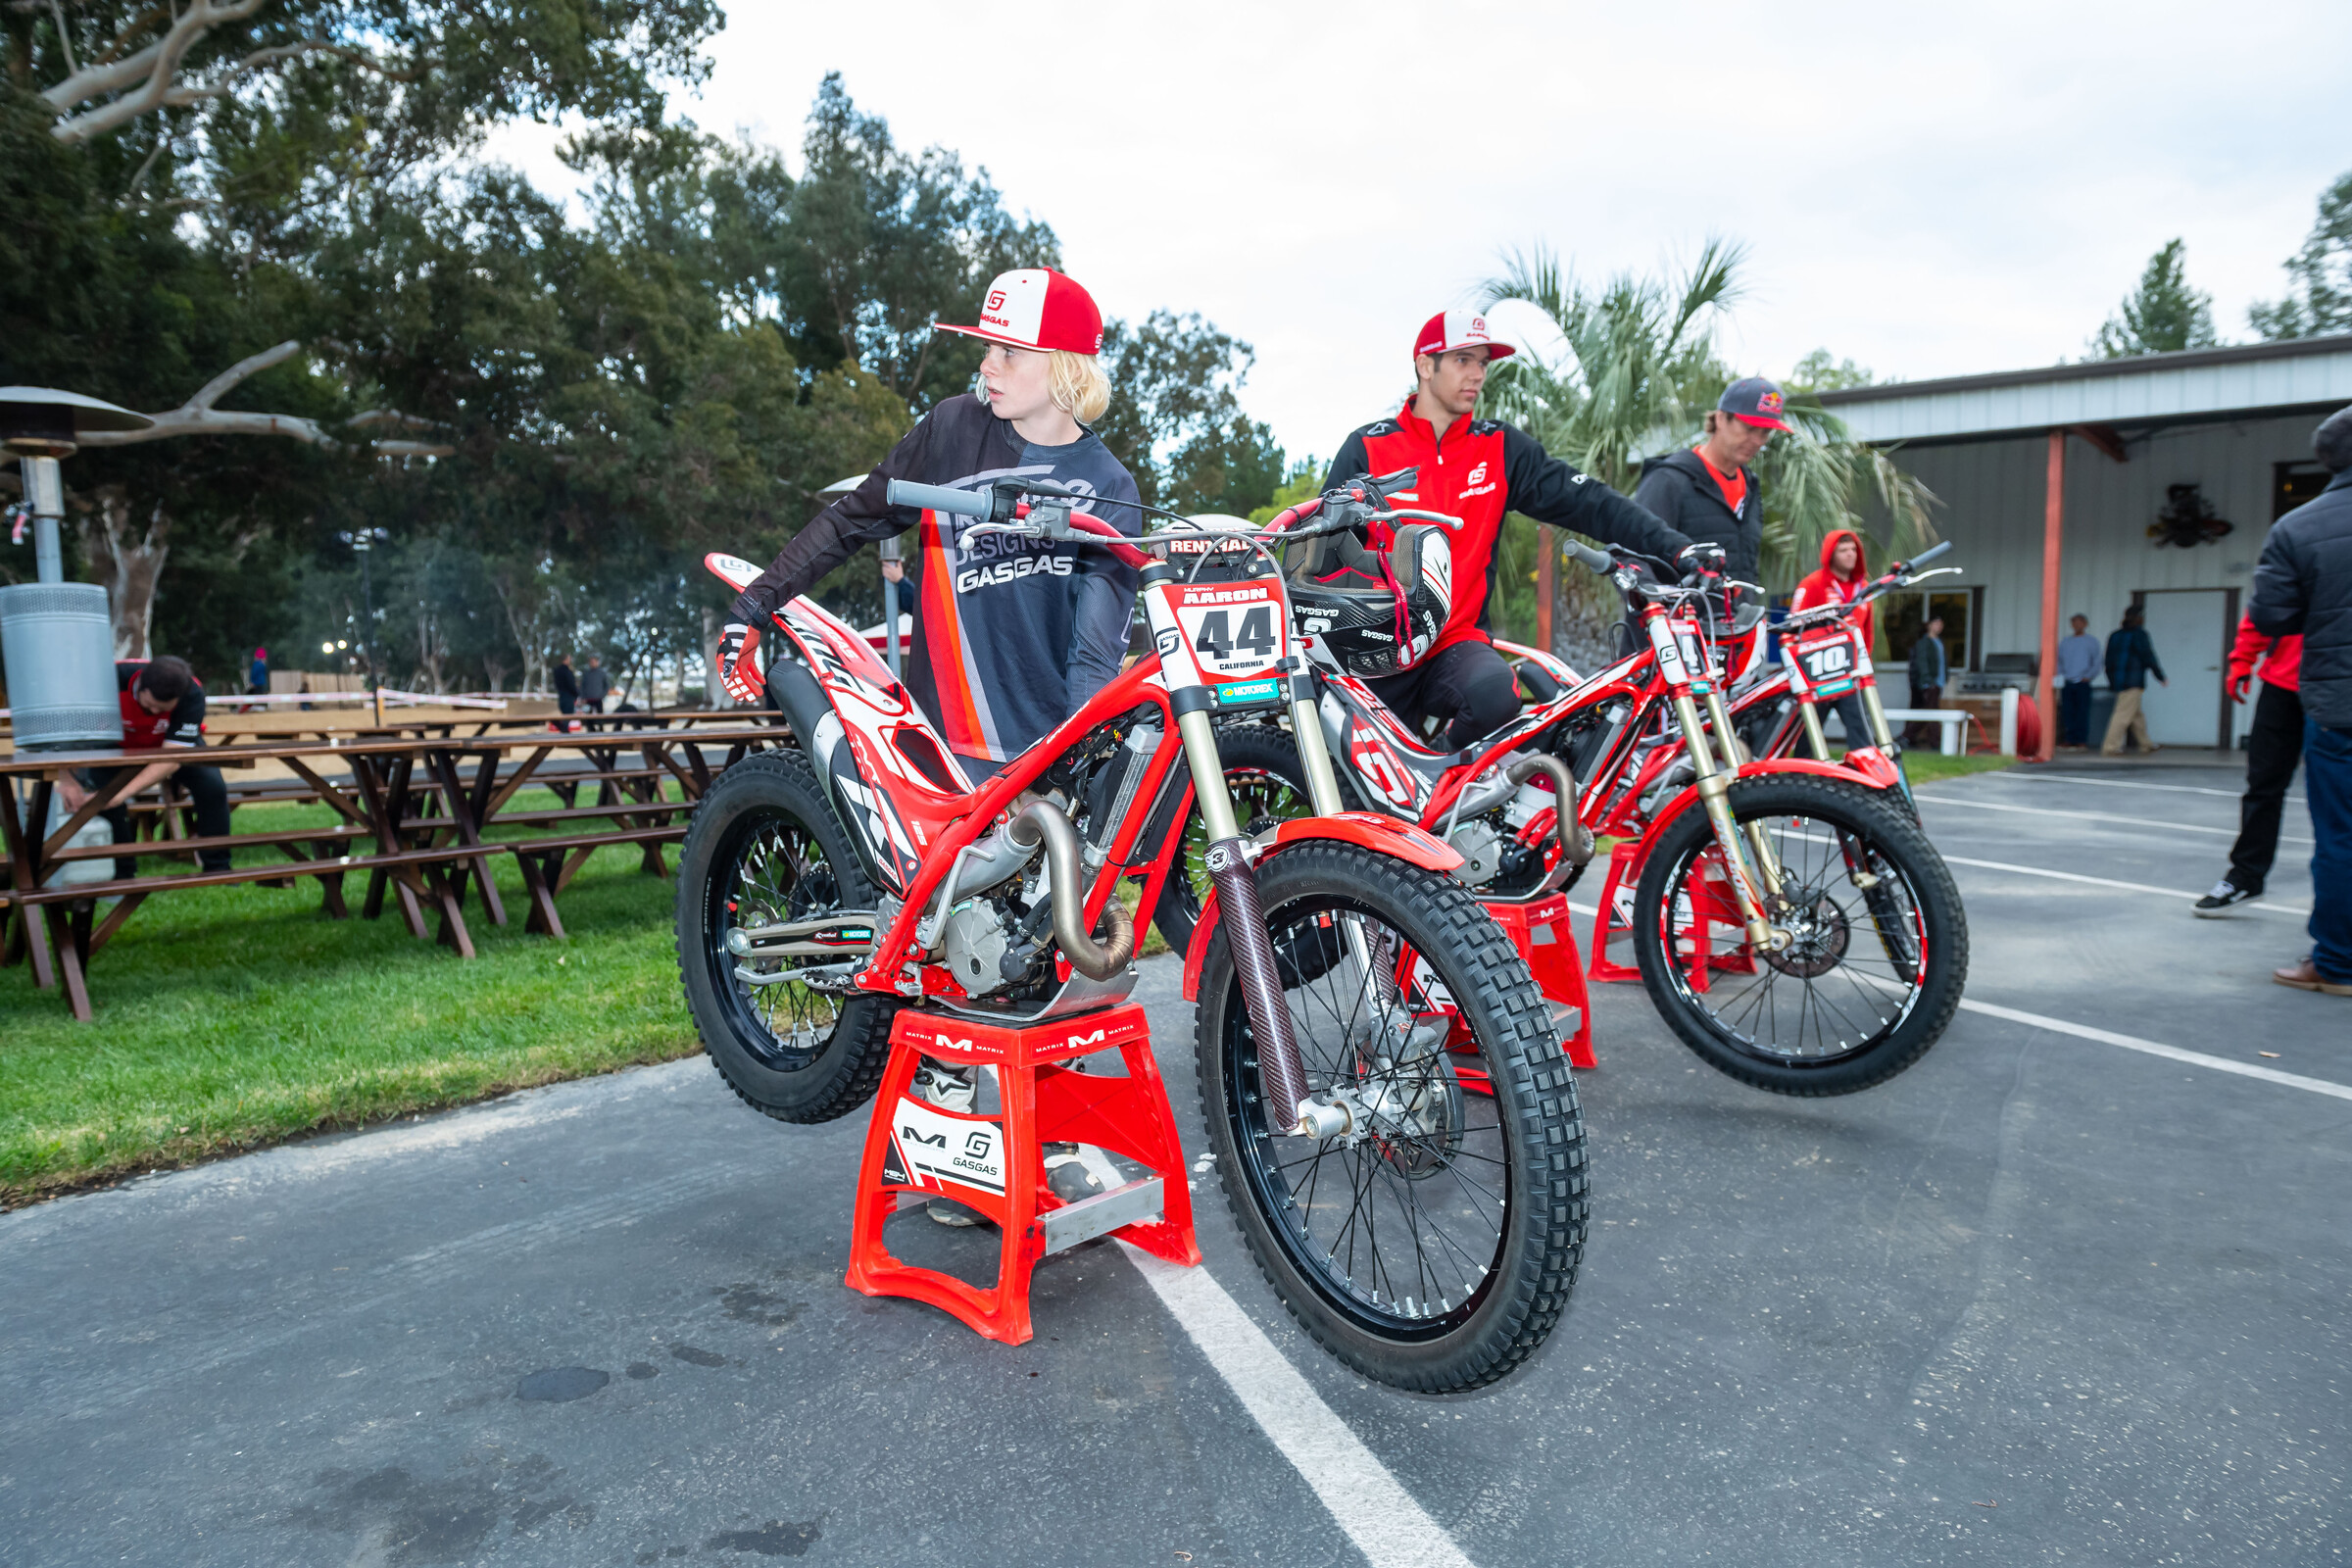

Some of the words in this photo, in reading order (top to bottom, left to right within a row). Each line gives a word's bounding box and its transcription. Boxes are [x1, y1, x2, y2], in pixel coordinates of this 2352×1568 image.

[1170, 539, 1250, 554] RENTHAL
[956, 555, 1074, 594] GASGAS
[1183, 588, 1268, 605] AARON
[1295, 605, 1340, 617] GASGAS
[1196, 606, 1276, 660] 44
[1361, 629, 1394, 642] GASGAS
[1219, 660, 1264, 670] CALIFORNIA
[1805, 645, 1846, 677] 10
[1234, 683, 1273, 696] MOTOREX
[910, 820, 928, 846] 125
[878, 858, 898, 880] GASGAS
[1713, 817, 1751, 902] DUNLOP
[906, 1031, 932, 1041] MATRIX
[976, 1045, 1004, 1054] MATRIX
[1036, 1042, 1064, 1053] MATRIX
[1107, 1024, 1134, 1035] MATRIX
[953, 1156, 998, 1176] GASGAS
